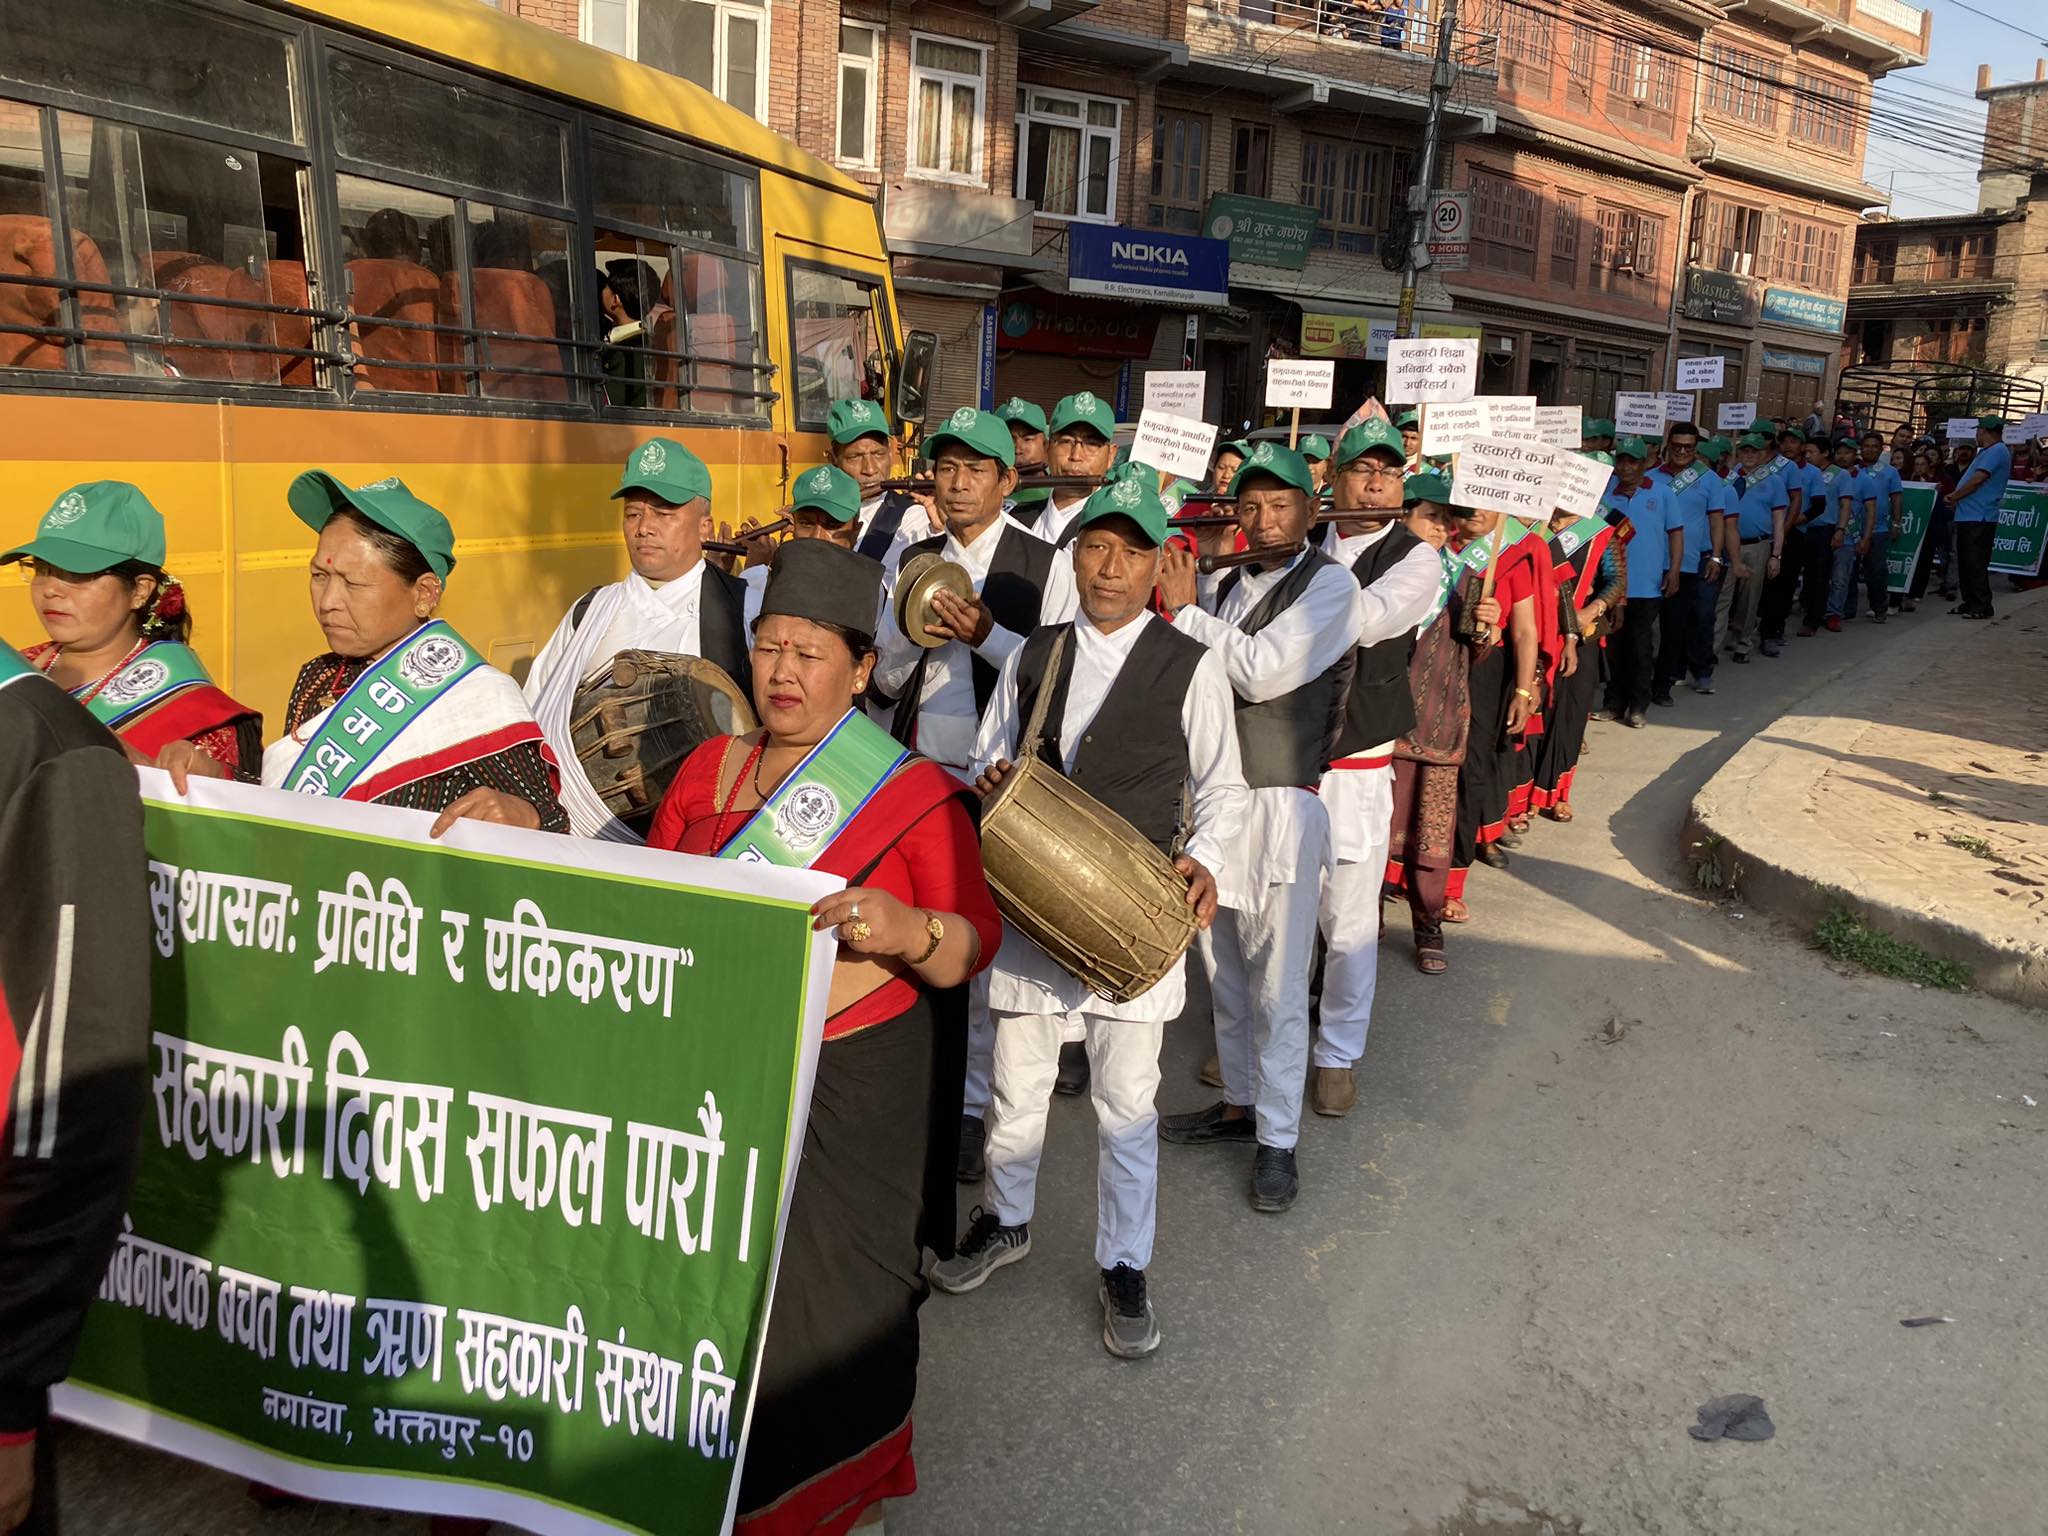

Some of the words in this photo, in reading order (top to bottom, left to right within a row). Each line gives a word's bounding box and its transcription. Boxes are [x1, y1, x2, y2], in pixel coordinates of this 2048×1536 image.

[1440, 207, 1456, 222] 20
[1235, 217, 1252, 233] श्री
[1277, 224, 1309, 240] गणेश
[1112, 241, 1189, 266] NOKIA
[1438, 245, 1468, 253] HORN
[985, 315, 994, 357] SAMSUNG
[1400, 347, 1437, 358] सहकारी
[1440, 346, 1465, 358] शिक्षा
[982, 360, 992, 391] Galaxy
[1396, 364, 1433, 374] अनिवार्य
[1141, 433, 1181, 449] सहकारीको
[1472, 441, 1521, 461] सहकारी
[1525, 451, 1556, 467] कर्जा
[1473, 463, 1509, 479] सूचना
[1512, 469, 1544, 486] केन्द्र
[1464, 482, 1509, 502] स्थापना
[1513, 492, 1534, 506] गर
[1998, 508, 2017, 528] फल
[148, 860, 300, 958] सुशासन:
[314, 871, 423, 976] प्रविधि
[441, 909, 470, 984] र
[484, 898, 694, 1018] एकिकरण”
[153, 1025, 313, 1179] सहकारी
[323, 1030, 454, 1203] दिवस
[466, 1091, 613, 1227] सफल
[625, 1089, 725, 1255] पारौ
[738, 1147, 759, 1262] ।
[217, 1265, 282, 1361] बचत
[289, 1285, 356, 1373] तथा
[364, 1297, 448, 1383] ऋण
[455, 1304, 588, 1414] सहकारी
[595, 1326, 683, 1441] संस्था
[687, 1338, 736, 1459] लि.
[373, 1407, 534, 1462] भक्तपुर-१०
